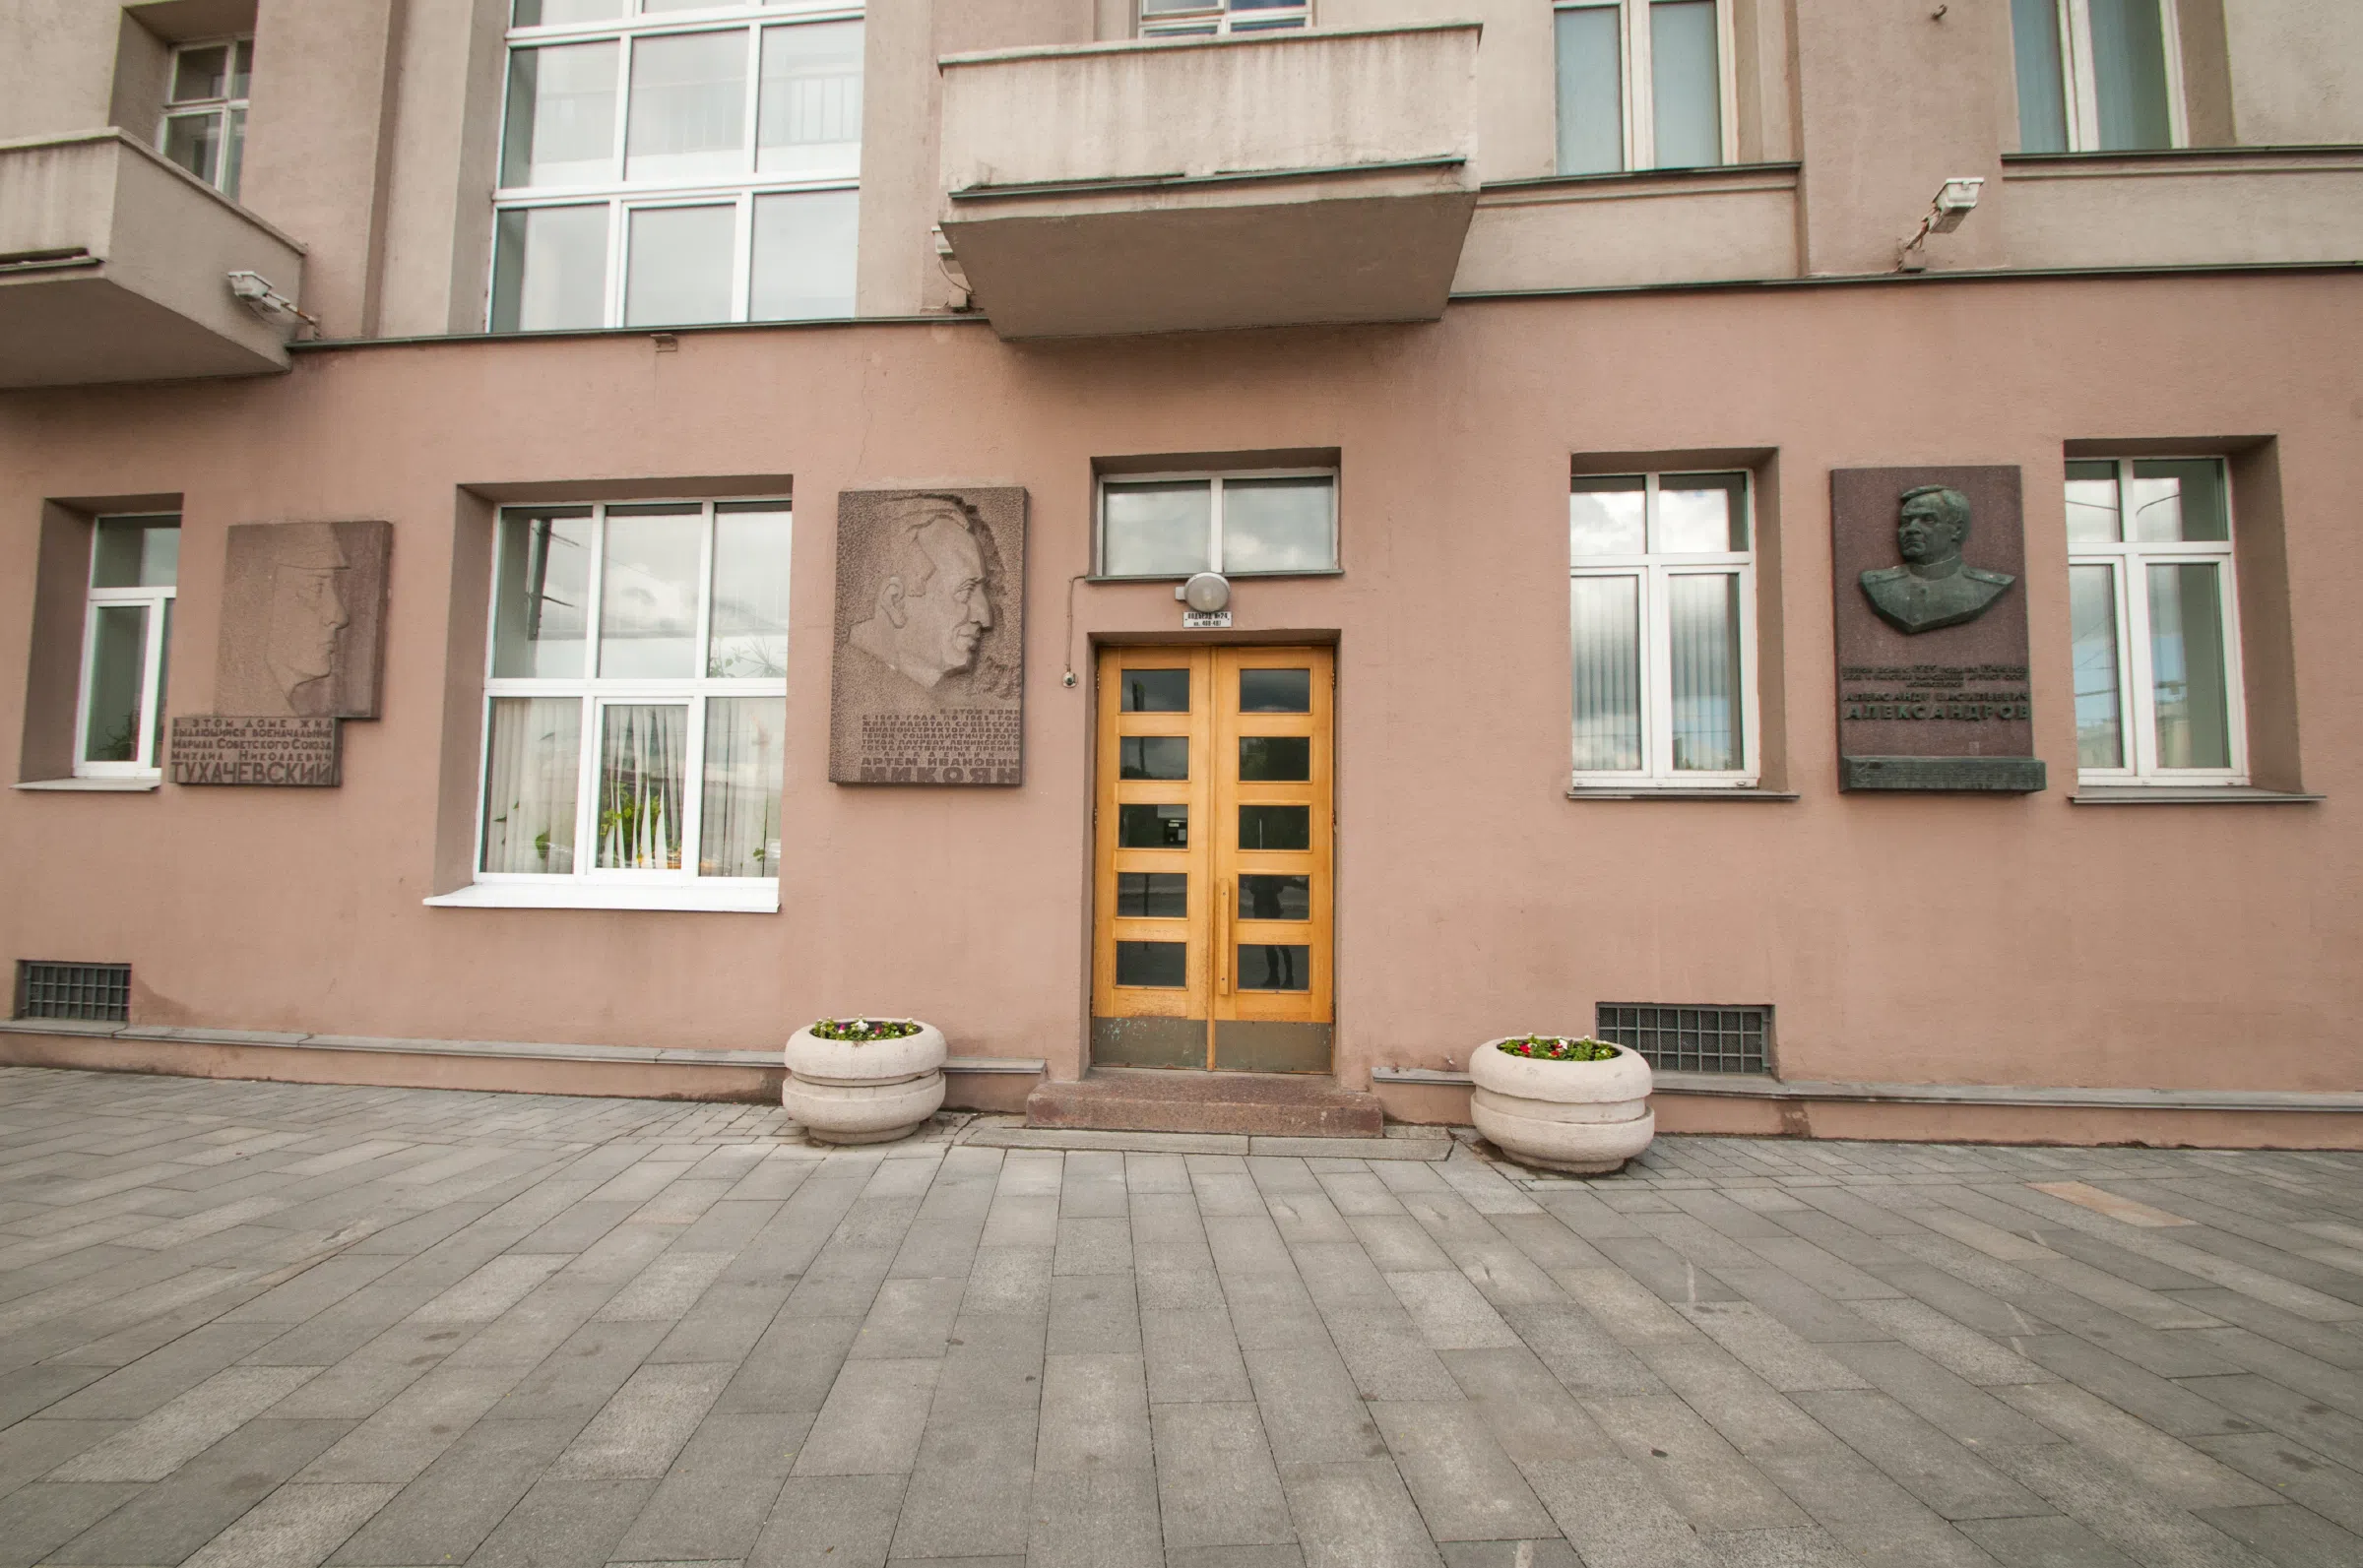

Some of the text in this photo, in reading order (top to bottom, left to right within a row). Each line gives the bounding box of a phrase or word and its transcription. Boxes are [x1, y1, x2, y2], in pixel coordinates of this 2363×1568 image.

[1844, 705, 2029, 721] АЛЕКСАНДРОВ
[173, 728, 246, 737] ВЫДАЮЩИЙСЯ
[217, 738, 289, 749] СОВЕТСКОГО
[291, 738, 332, 750] СОЮЗА
[171, 750, 332, 761] МИХАИЛ НИКОЛАЕВИЧ
[927, 758, 1020, 767] ИВАНОВИЧ
[170, 762, 332, 784] ТУХАЧЕВСКИЙ
[861, 767, 1020, 783] МИКОЯН
